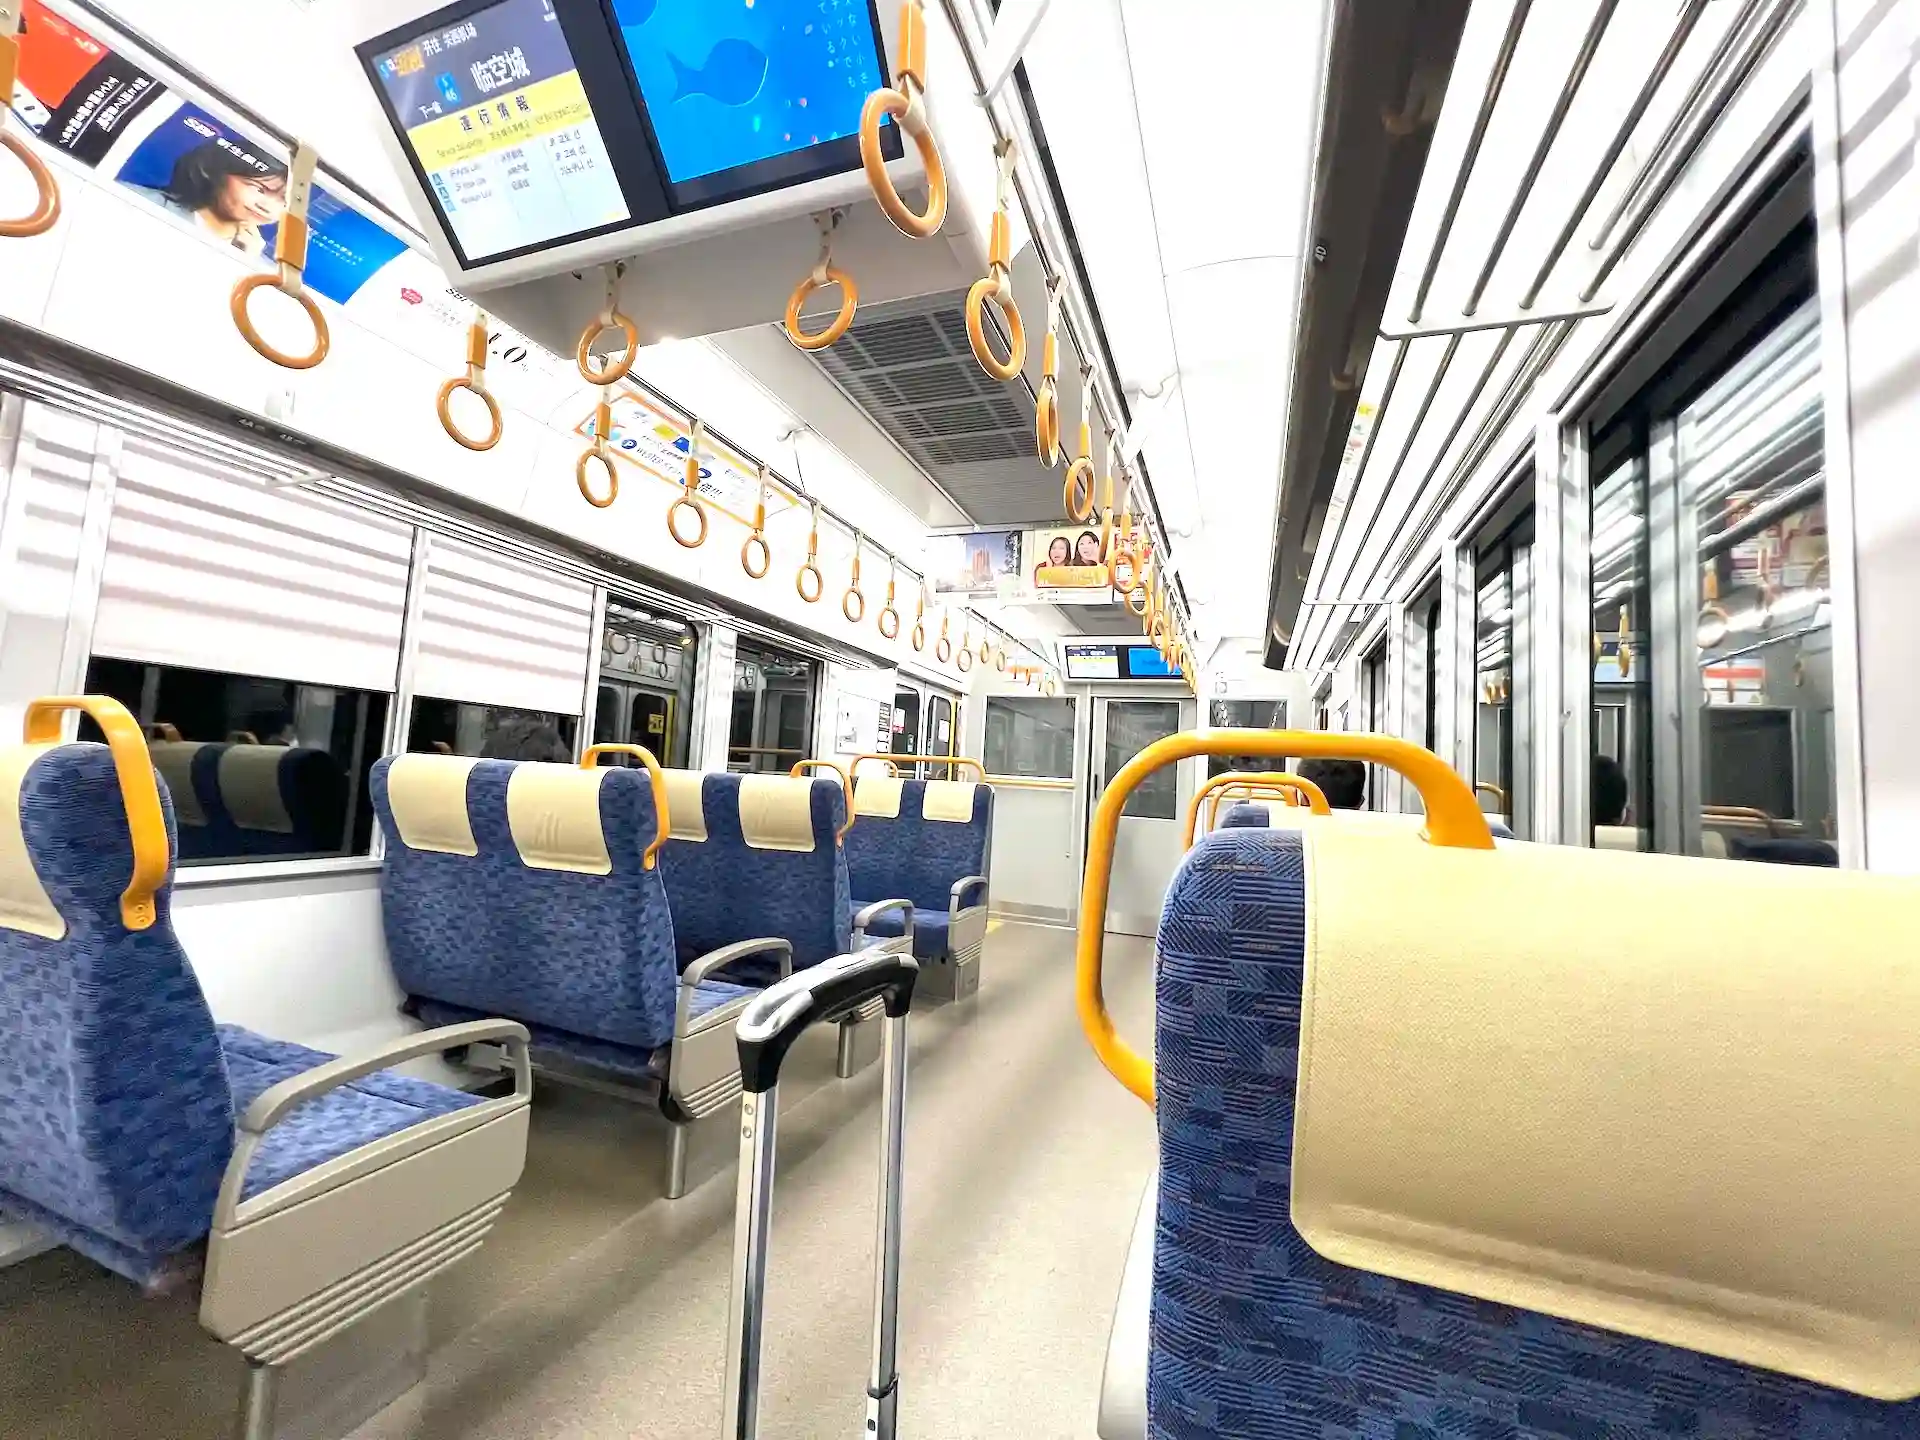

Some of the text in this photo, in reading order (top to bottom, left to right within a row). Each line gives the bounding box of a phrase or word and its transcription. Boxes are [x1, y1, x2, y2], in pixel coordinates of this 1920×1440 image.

[423, 37, 443, 57] 开往
[469, 46, 531, 93] 临空城
